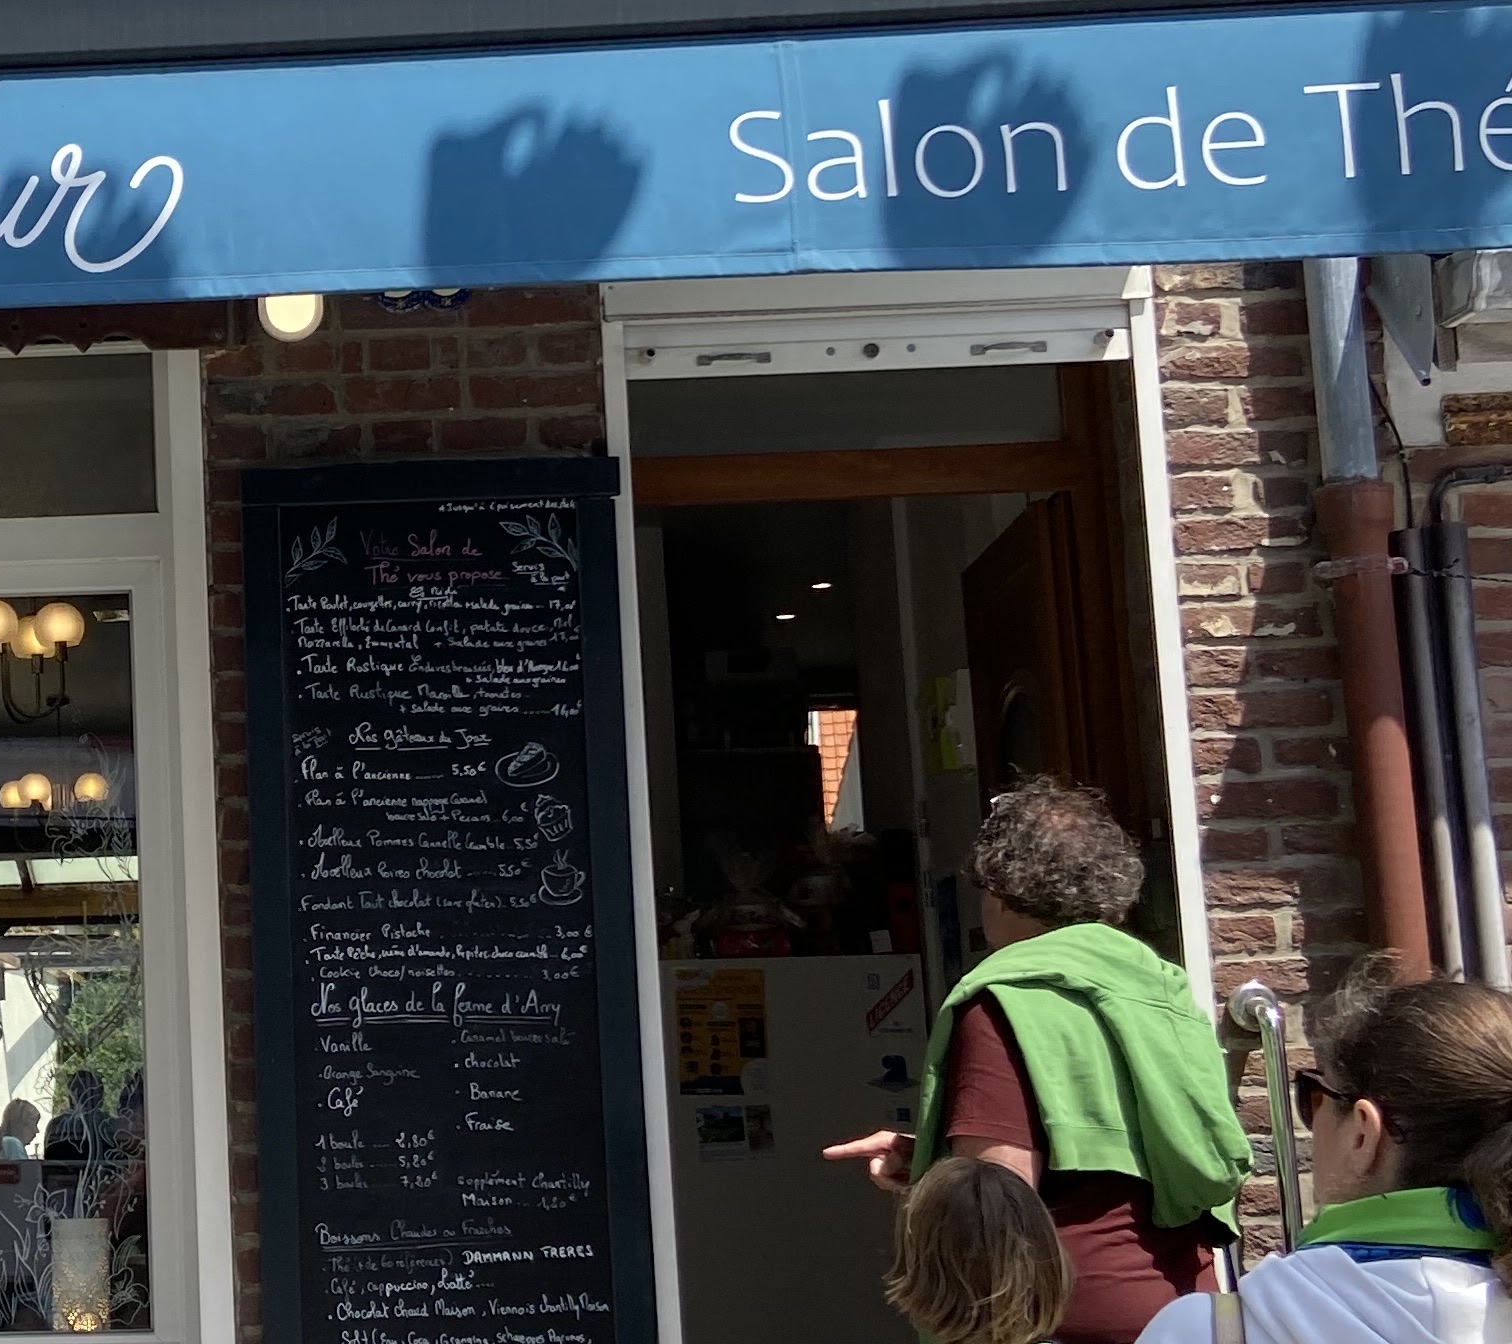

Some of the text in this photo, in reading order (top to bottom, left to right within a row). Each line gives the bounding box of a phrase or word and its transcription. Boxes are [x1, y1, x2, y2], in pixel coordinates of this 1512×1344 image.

[727, 99, 1070, 205] Salon
[1116, 85, 1268, 191] de
[359, 528, 483, 557] Votre Salon de
[363, 561, 400, 585] Thé
[407, 570, 442, 583] vous
[447, 569, 504, 594] propose
[348, 721, 378, 744] Nos
[438, 728, 453, 744] du
[454, 727, 493, 750] Jour
[301, 754, 329, 781] Flan
[334, 761, 345, 780] à
[351, 761, 411, 781] l'ancienne
[301, 894, 354, 912] Fondant
[357, 890, 385, 909] Tout
[310, 922, 372, 942] Financier
[381, 918, 432, 939] Pistache
[319, 965, 361, 980] Cookie
[311, 983, 343, 1016] Nos
[404, 991, 425, 1013] de
[431, 981, 446, 1013] la
[452, 981, 493, 1027] ferme
[320, 1029, 506, 1053] Vanille Caramel
[327, 1086, 365, 1117] Café
[468, 1082, 523, 1102] Banane
[464, 1112, 515, 1133] Fraise
[315, 1134, 326, 1149] 1
[328, 1131, 366, 1150] boule
[531, 1171, 591, 1198] Chantilly
[461, 1192, 513, 1208] Maison
[314, 1222, 381, 1247] Boissons
[389, 1218, 437, 1242] Chaudes
[462, 1243, 595, 1266] DAMMANN FRERES
[336, 1301, 390, 1322] Chocolat
[488, 1298, 536, 1316] Viennois
